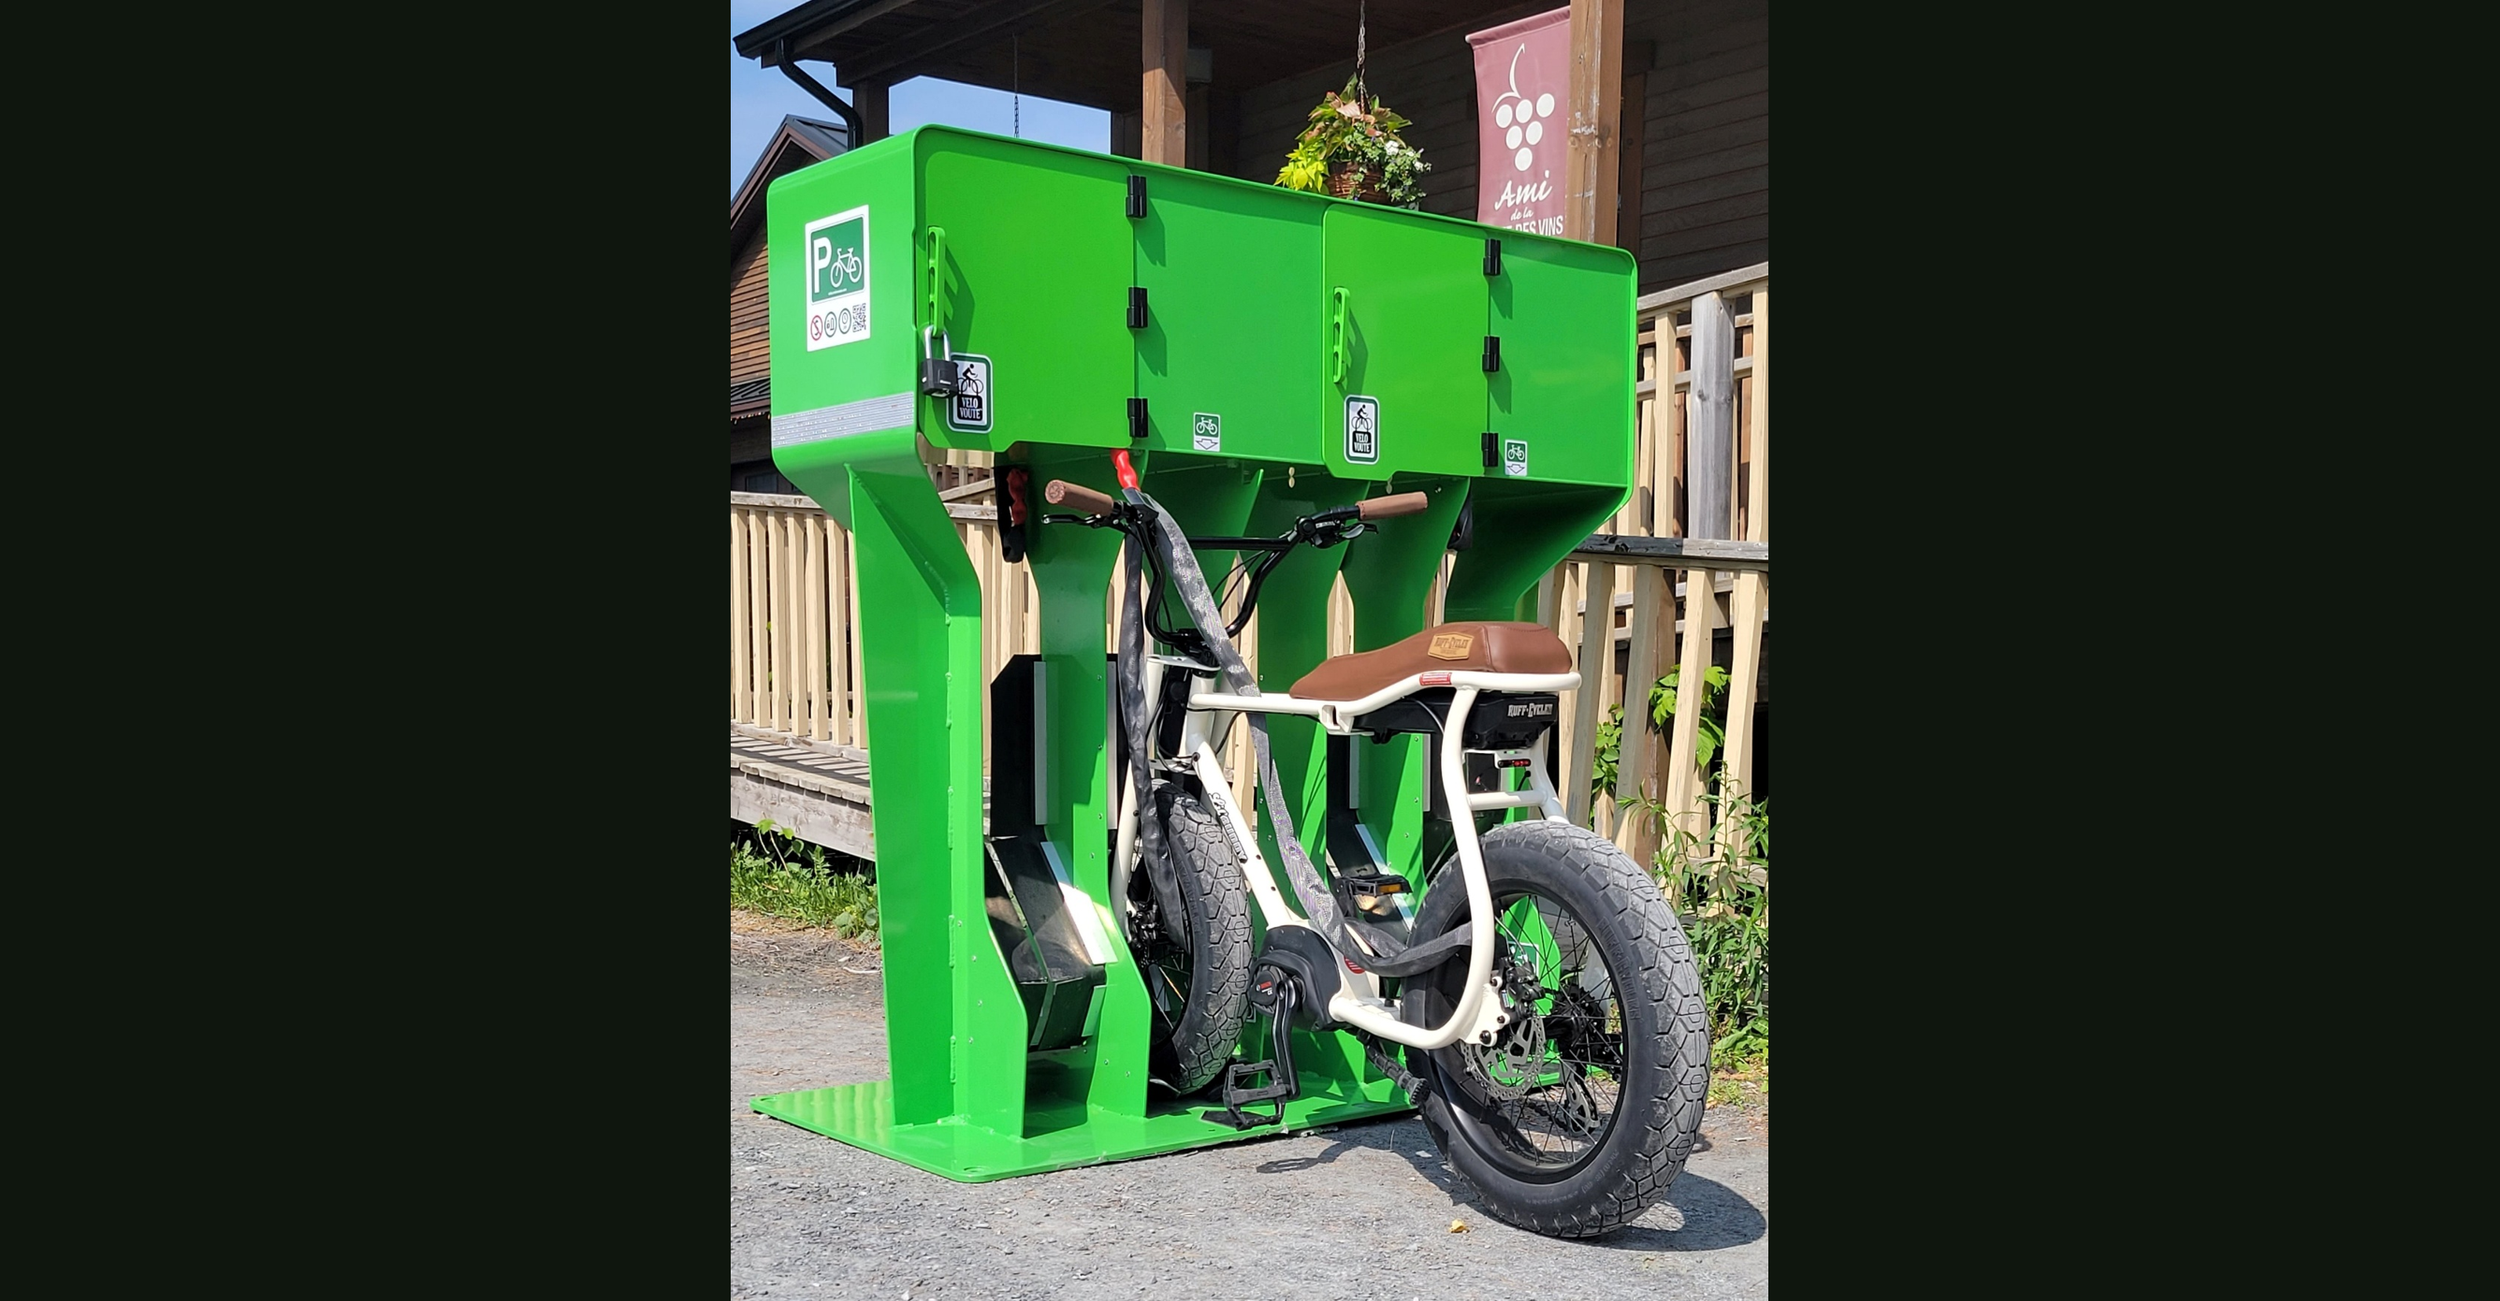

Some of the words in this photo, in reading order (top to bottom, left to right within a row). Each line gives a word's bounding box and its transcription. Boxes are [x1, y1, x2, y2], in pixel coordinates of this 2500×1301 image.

[1494, 169, 1553, 211] Ami
[1510, 208, 1522, 221] de
[1522, 206, 1534, 219] la
[1538, 214, 1564, 236] VINS
[813, 237, 832, 293] P
